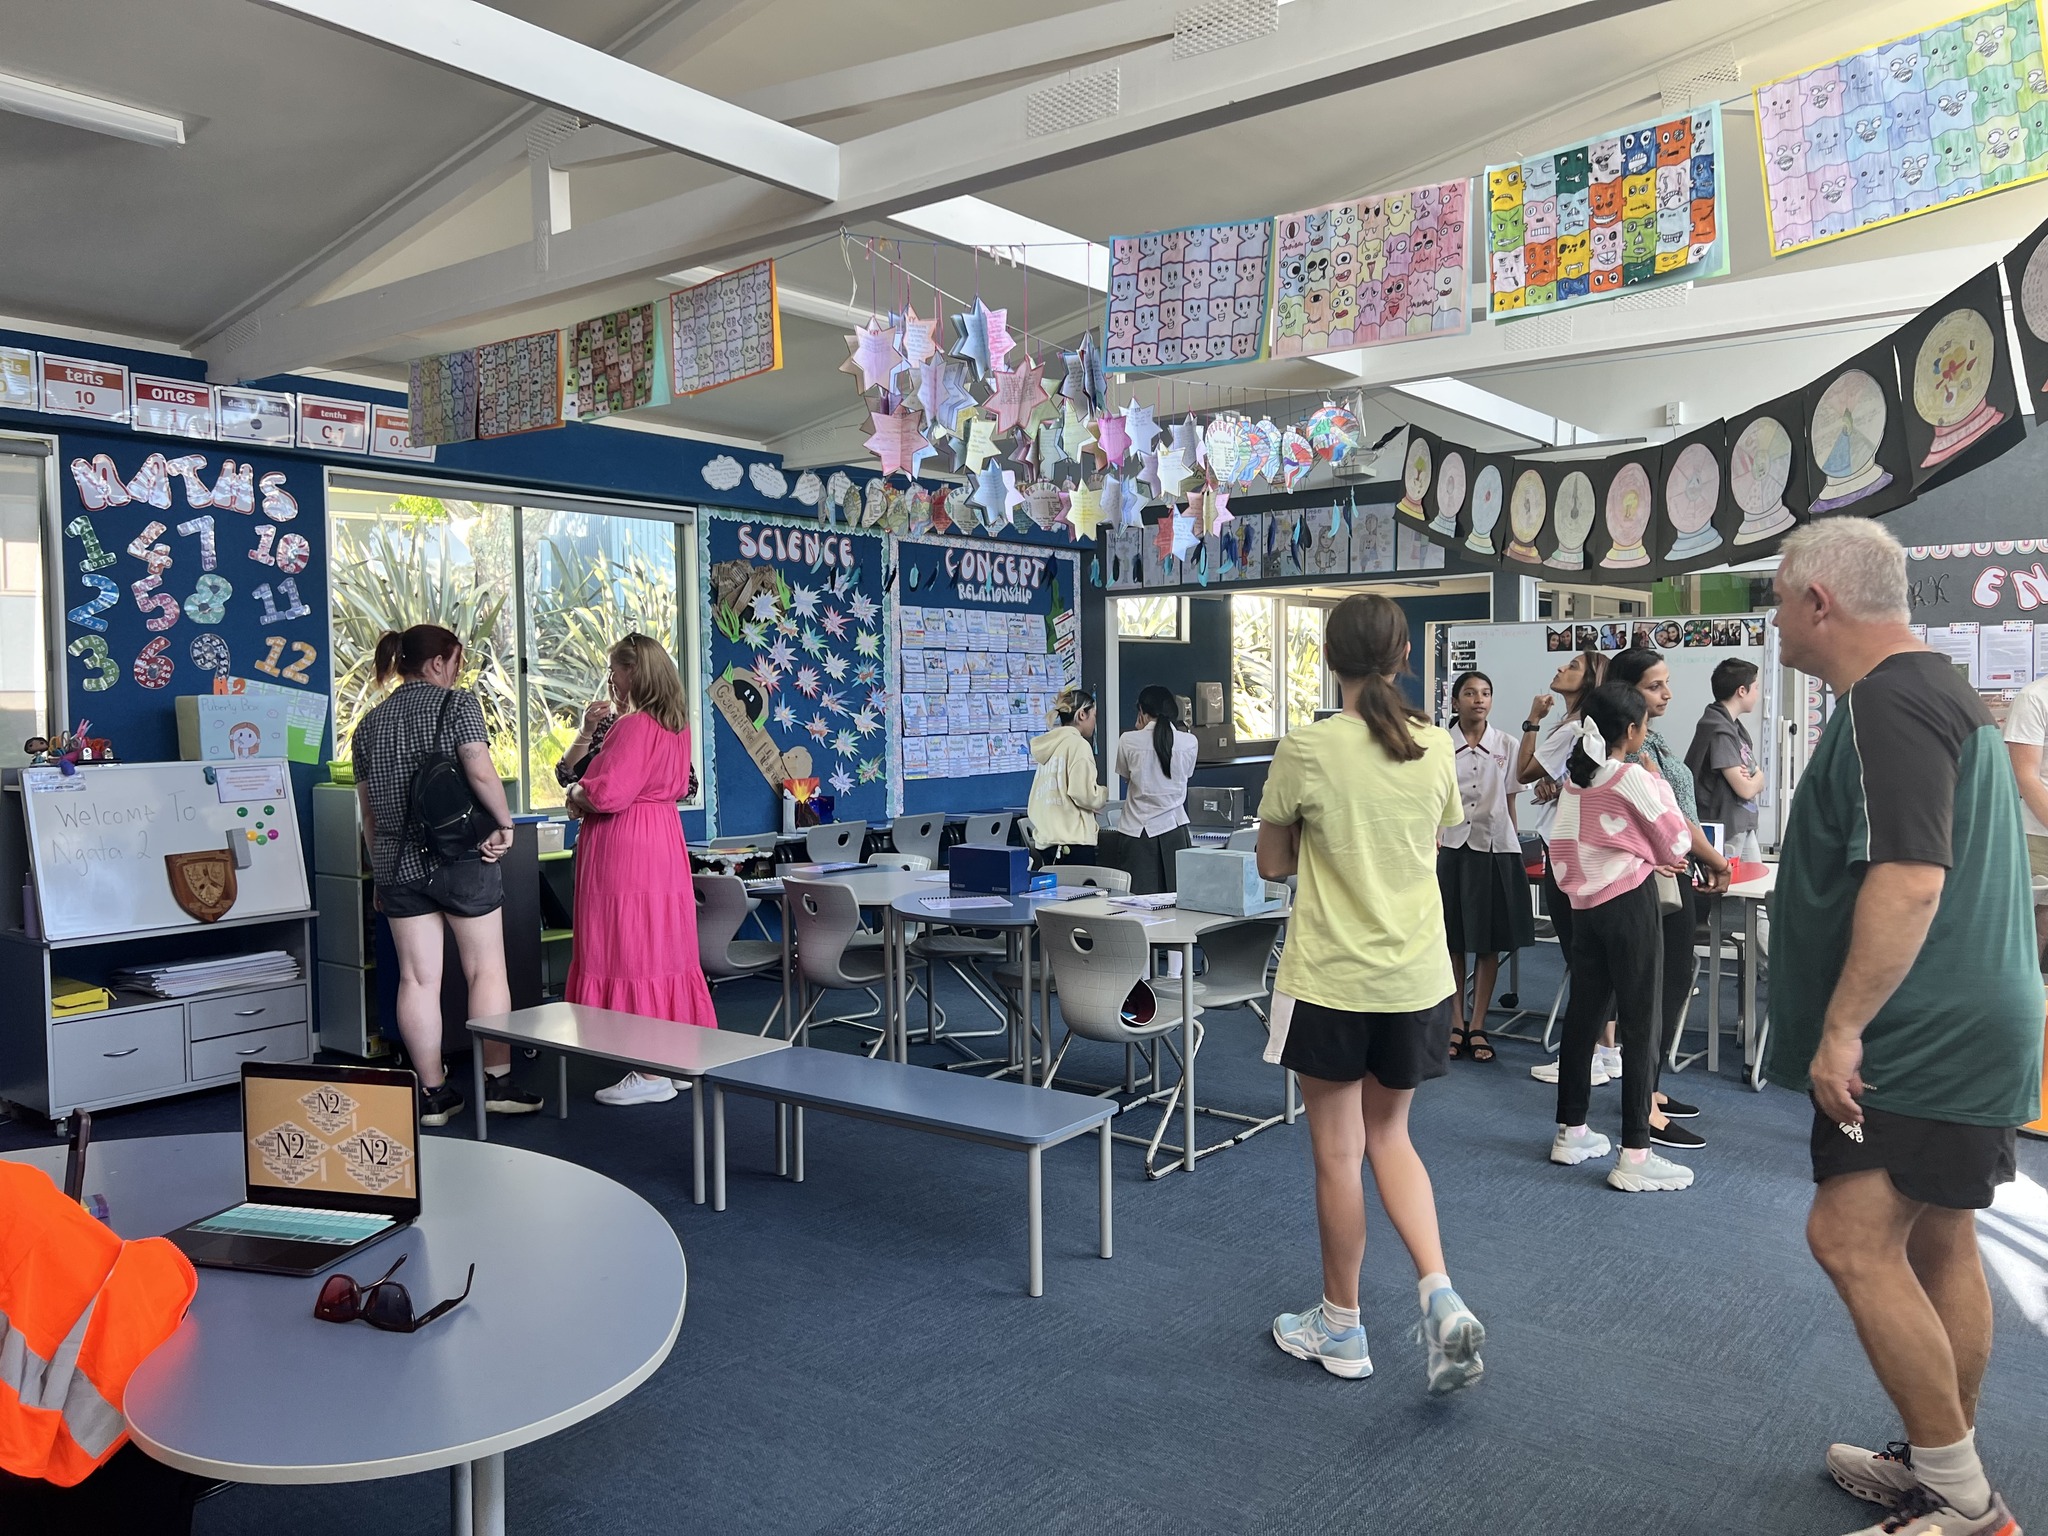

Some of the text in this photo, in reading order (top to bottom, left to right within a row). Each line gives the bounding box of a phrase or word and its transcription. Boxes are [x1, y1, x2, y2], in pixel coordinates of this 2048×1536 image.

[65, 368, 104, 386] tens
[75, 390, 96, 405] 10
[151, 387, 196, 404] ones
[228, 399, 257, 409] decima
[170, 408, 177, 423] 1
[321, 409, 347, 420] tenths
[387, 418, 409, 428] hundr
[390, 435, 410, 449] 0.0
[70, 452, 299, 523] MATHS
[65, 515, 310, 576] 1 4 7 10
[738, 524, 855, 569] SCIENCE
[945, 548, 1046, 589] CONCEPT
[68, 574, 311, 632] 2 5 8 11
[957, 583, 1033, 605] RELATIONSHIP
[1546, 617, 1766, 652] MRS KOSHY
[68, 633, 317, 692] 3 6 9 12
[232, 678, 245, 695] 2
[201, 697, 259, 715] Puberty Box
[55, 790, 196, 828] Welcome To
[52, 830, 153, 877] Ngata 2
[317, 1093, 339, 1114] N2
[276, 1132, 304, 1159] N2
[360, 1138, 388, 1165] N2
